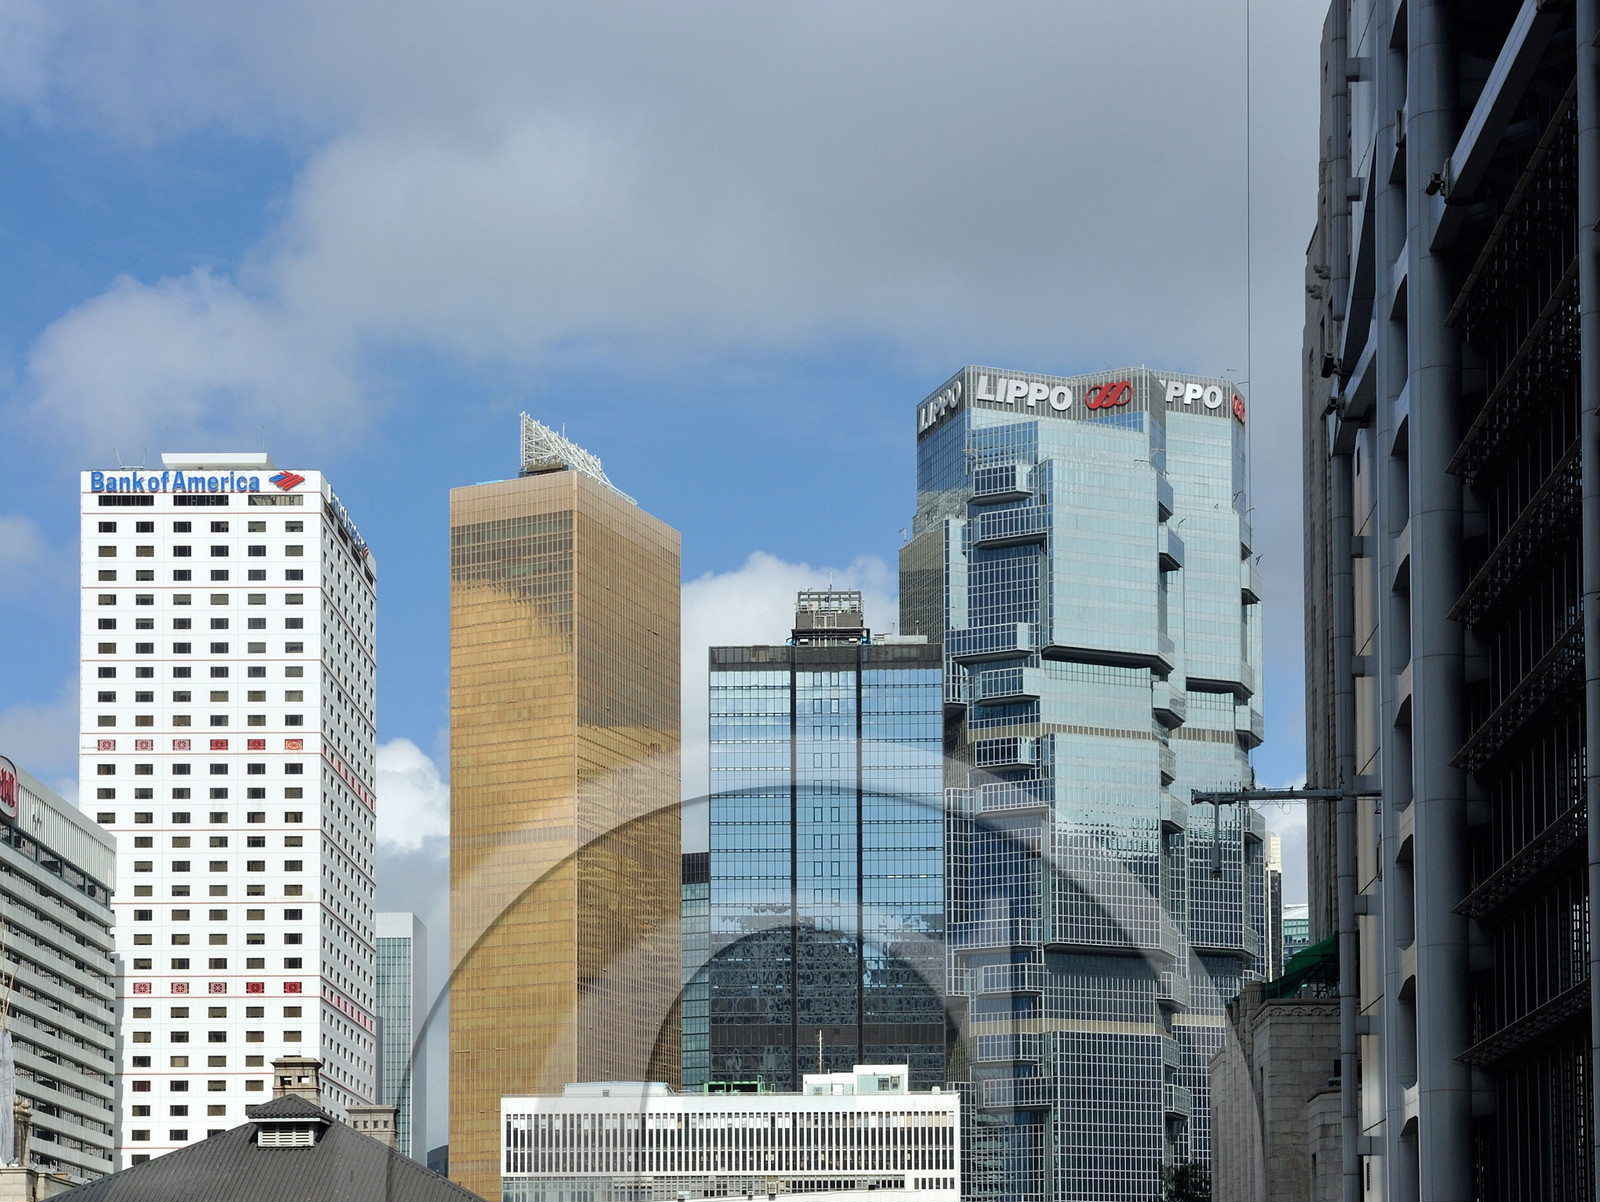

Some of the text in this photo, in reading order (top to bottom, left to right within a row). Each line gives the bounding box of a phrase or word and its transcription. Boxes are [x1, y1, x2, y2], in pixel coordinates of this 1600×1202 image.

[919, 380, 962, 433] LIPPO
[976, 375, 1073, 411] LIPPO
[1159, 379, 1223, 410] PPO
[91, 471, 260, 493] Bank of America
